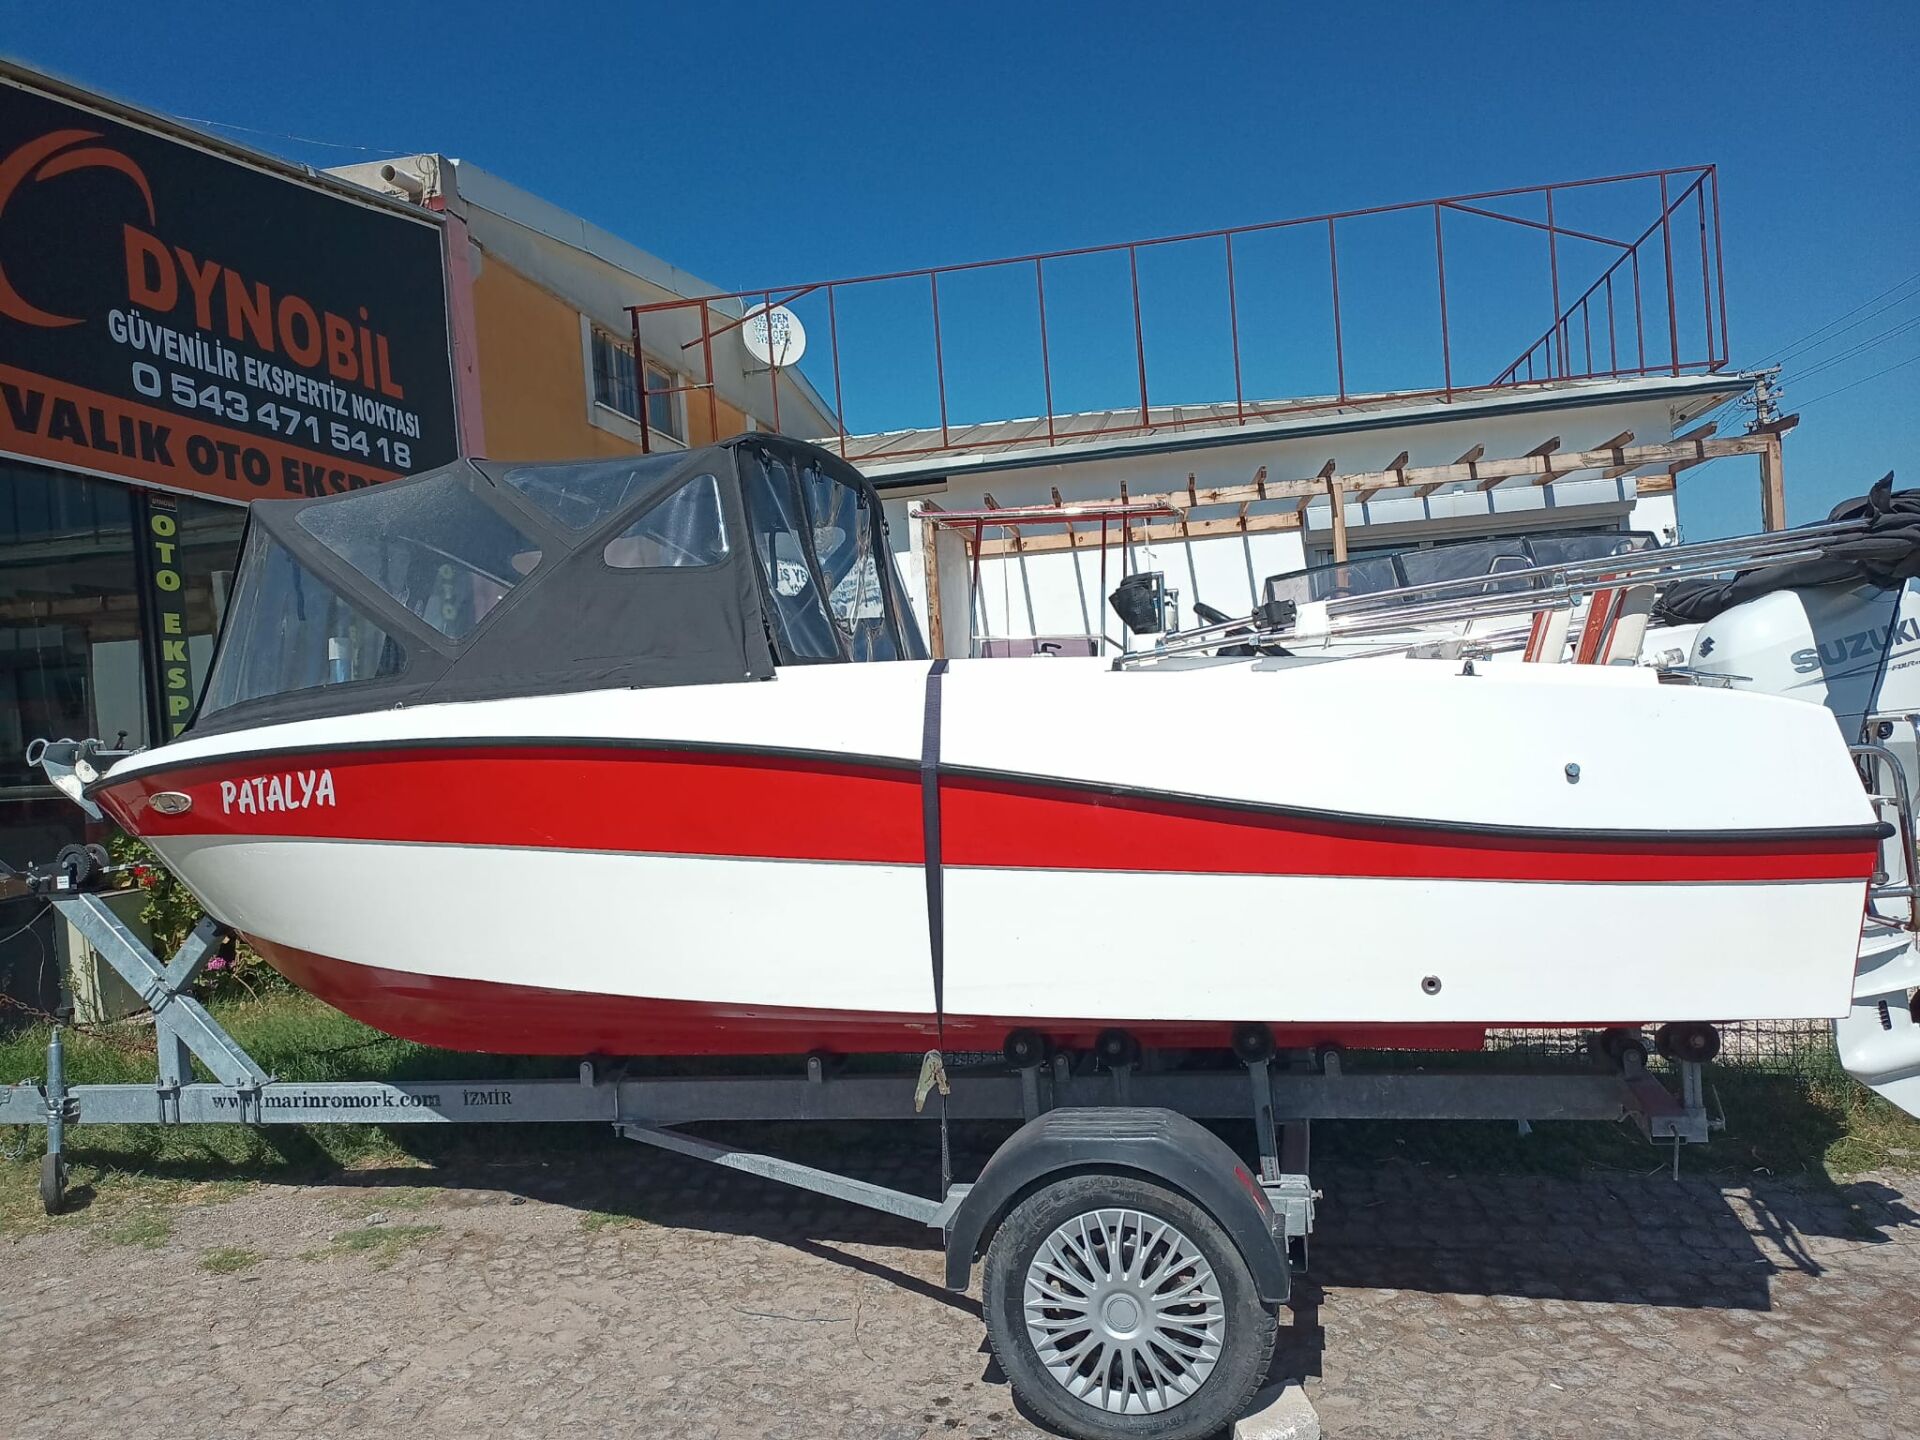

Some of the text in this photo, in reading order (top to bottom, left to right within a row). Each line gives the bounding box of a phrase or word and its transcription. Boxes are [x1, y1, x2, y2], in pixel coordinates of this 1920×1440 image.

[123, 223, 404, 399] DYNOBİL
[108, 308, 421, 439] GÜVENİLİR EKSPERTİZ NOKTASI
[132, 361, 162, 398] 0
[170, 372, 250, 423] 543
[256, 402, 320, 444] 471
[1, 382, 383, 497] VALIK OTO EKSP
[151, 514, 181, 591] OTO
[1790, 617, 1920, 674] SUZUKI
[219, 769, 337, 815] PATALYA
[212, 1089, 512, 1109] ww.marinromork.com İZMİR
